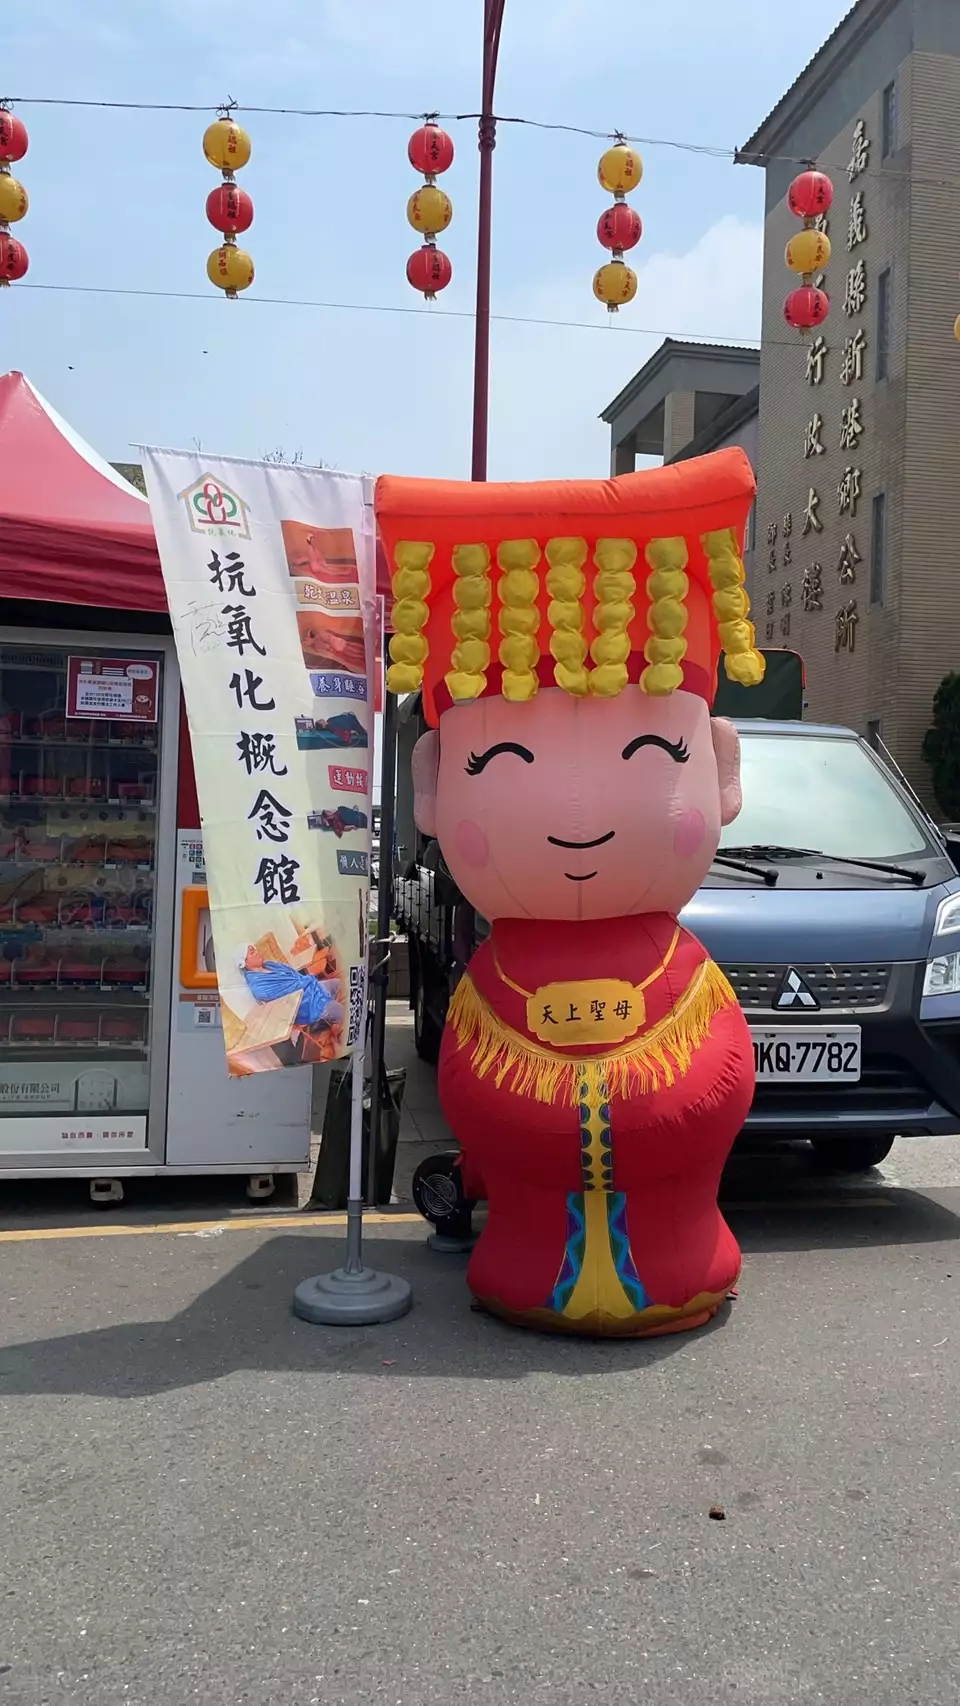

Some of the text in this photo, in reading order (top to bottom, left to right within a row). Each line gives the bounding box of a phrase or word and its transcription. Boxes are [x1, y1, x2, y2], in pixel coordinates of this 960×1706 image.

[834, 118, 869, 653] 嘉義縣新港鄉公所
[207, 548, 301, 905] 抗氧化概念館
[540, 1000, 633, 1025] 天上聖母
